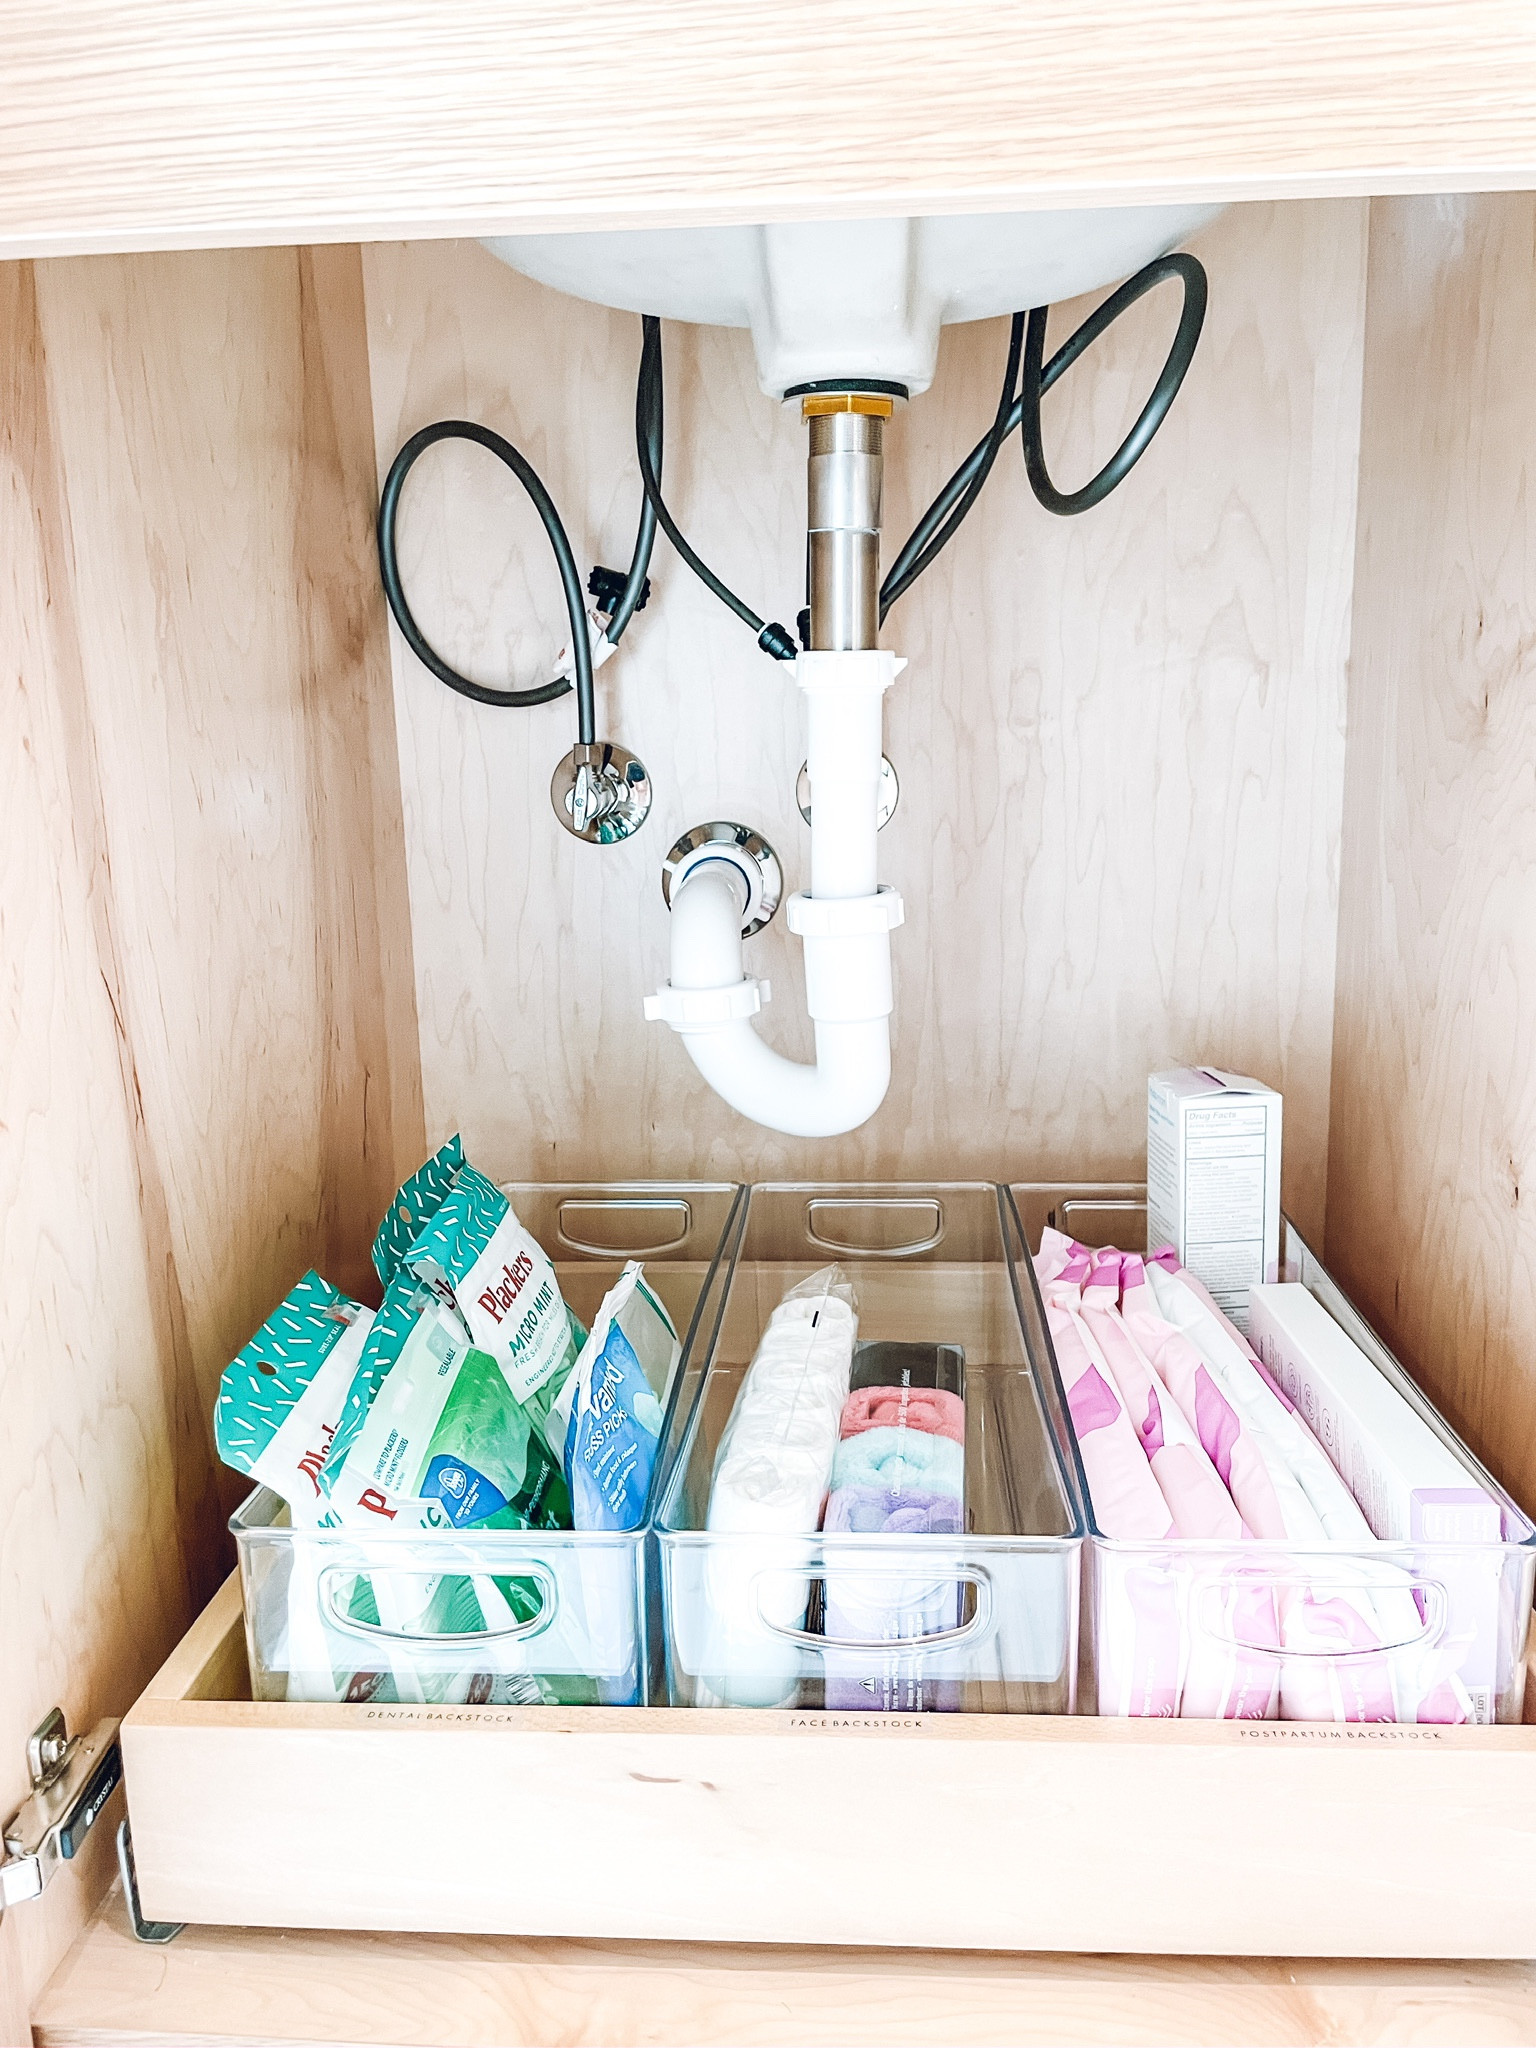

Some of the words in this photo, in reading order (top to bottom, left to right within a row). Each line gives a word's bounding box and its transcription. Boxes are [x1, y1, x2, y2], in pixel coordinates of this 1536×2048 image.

[1188, 1112, 1210, 1120] Drug
[1212, 1110, 1236, 1119] Facts
[478, 1250, 534, 1325] Plackers
[508, 1311, 539, 1358] MICRO
[536, 1281, 555, 1317] MINT
[467, 1477, 480, 1497] FAMILY
[1145, 1656, 1158, 1677] pop
[1143, 1677, 1153, 1694] the
[1238, 1684, 1249, 1698] the
[1140, 1695, 1151, 1716] hear
[426, 1713, 513, 1722] BACKSTOCK
[791, 1719, 827, 1727] FACE
[1240, 1730, 1341, 1739] POSTPARTUM
[1346, 1731, 1442, 1739] BACKSTOCK
